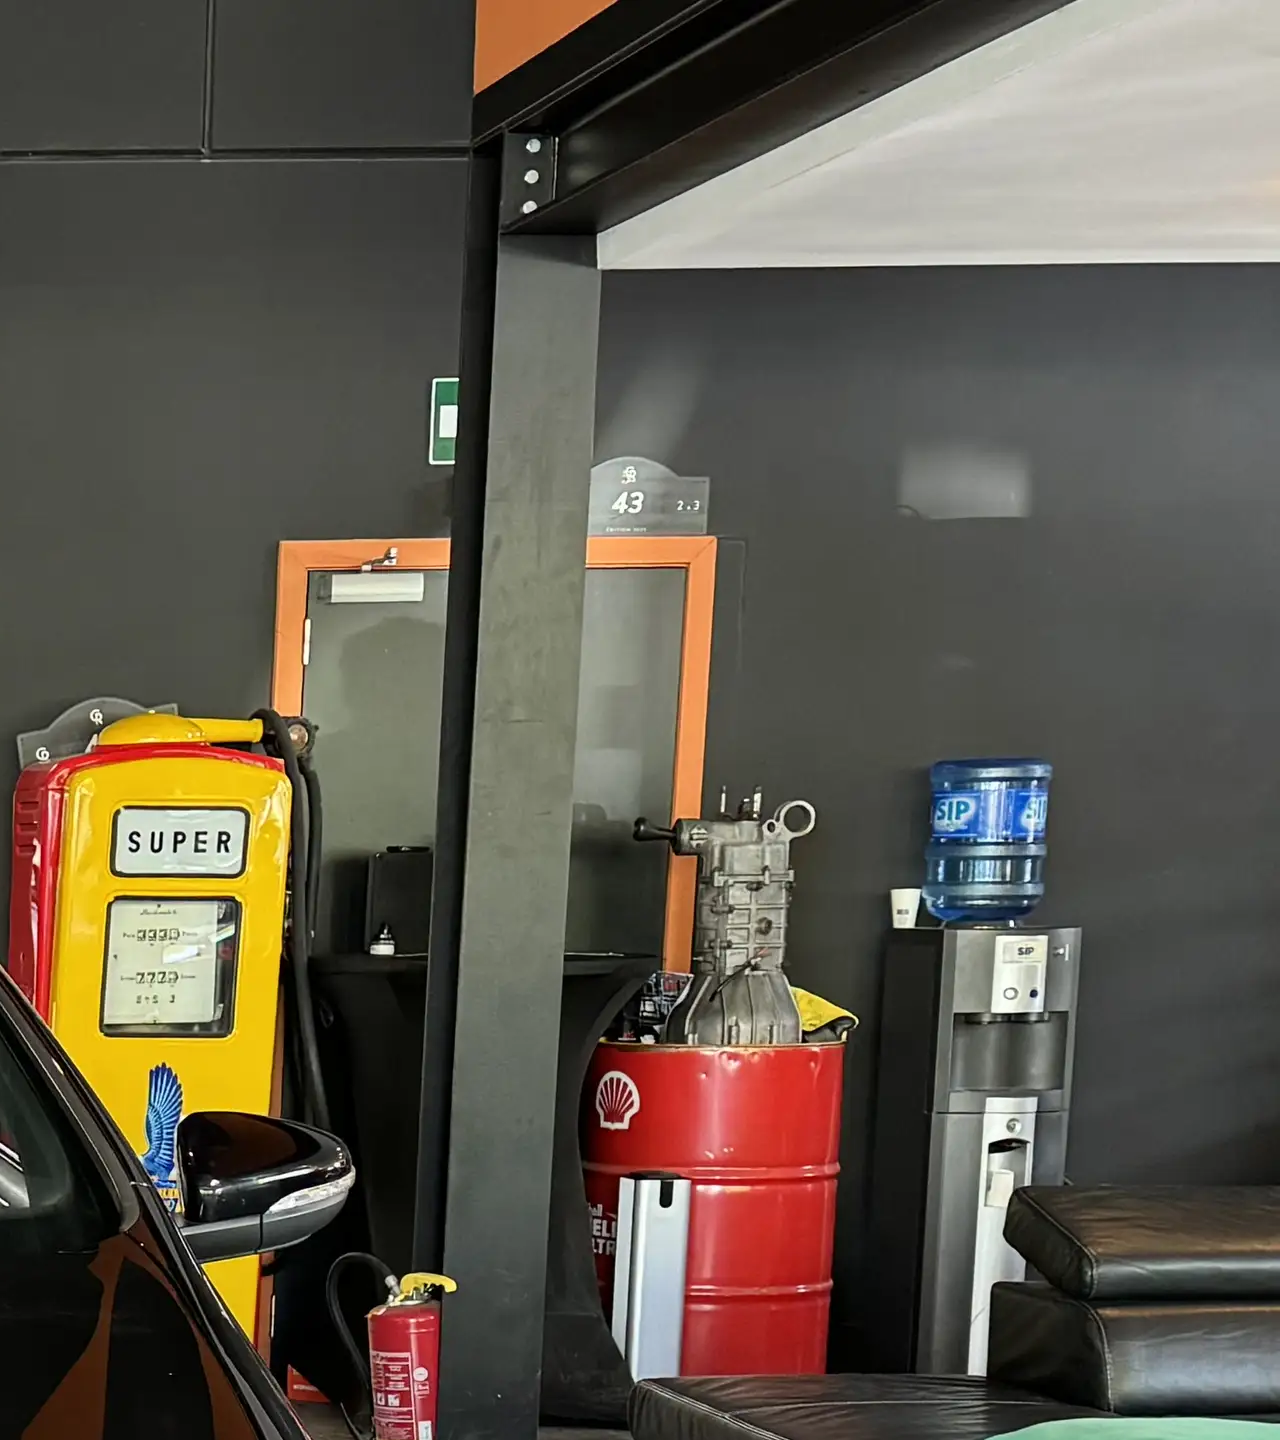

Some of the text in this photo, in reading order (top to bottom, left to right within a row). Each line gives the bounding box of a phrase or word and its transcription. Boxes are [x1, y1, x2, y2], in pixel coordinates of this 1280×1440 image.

[611, 491, 701, 514] 43 2.3
[937, 800, 971, 821] SIP
[128, 831, 231, 854] SUPER
[1017, 946, 1035, 956] SIP
